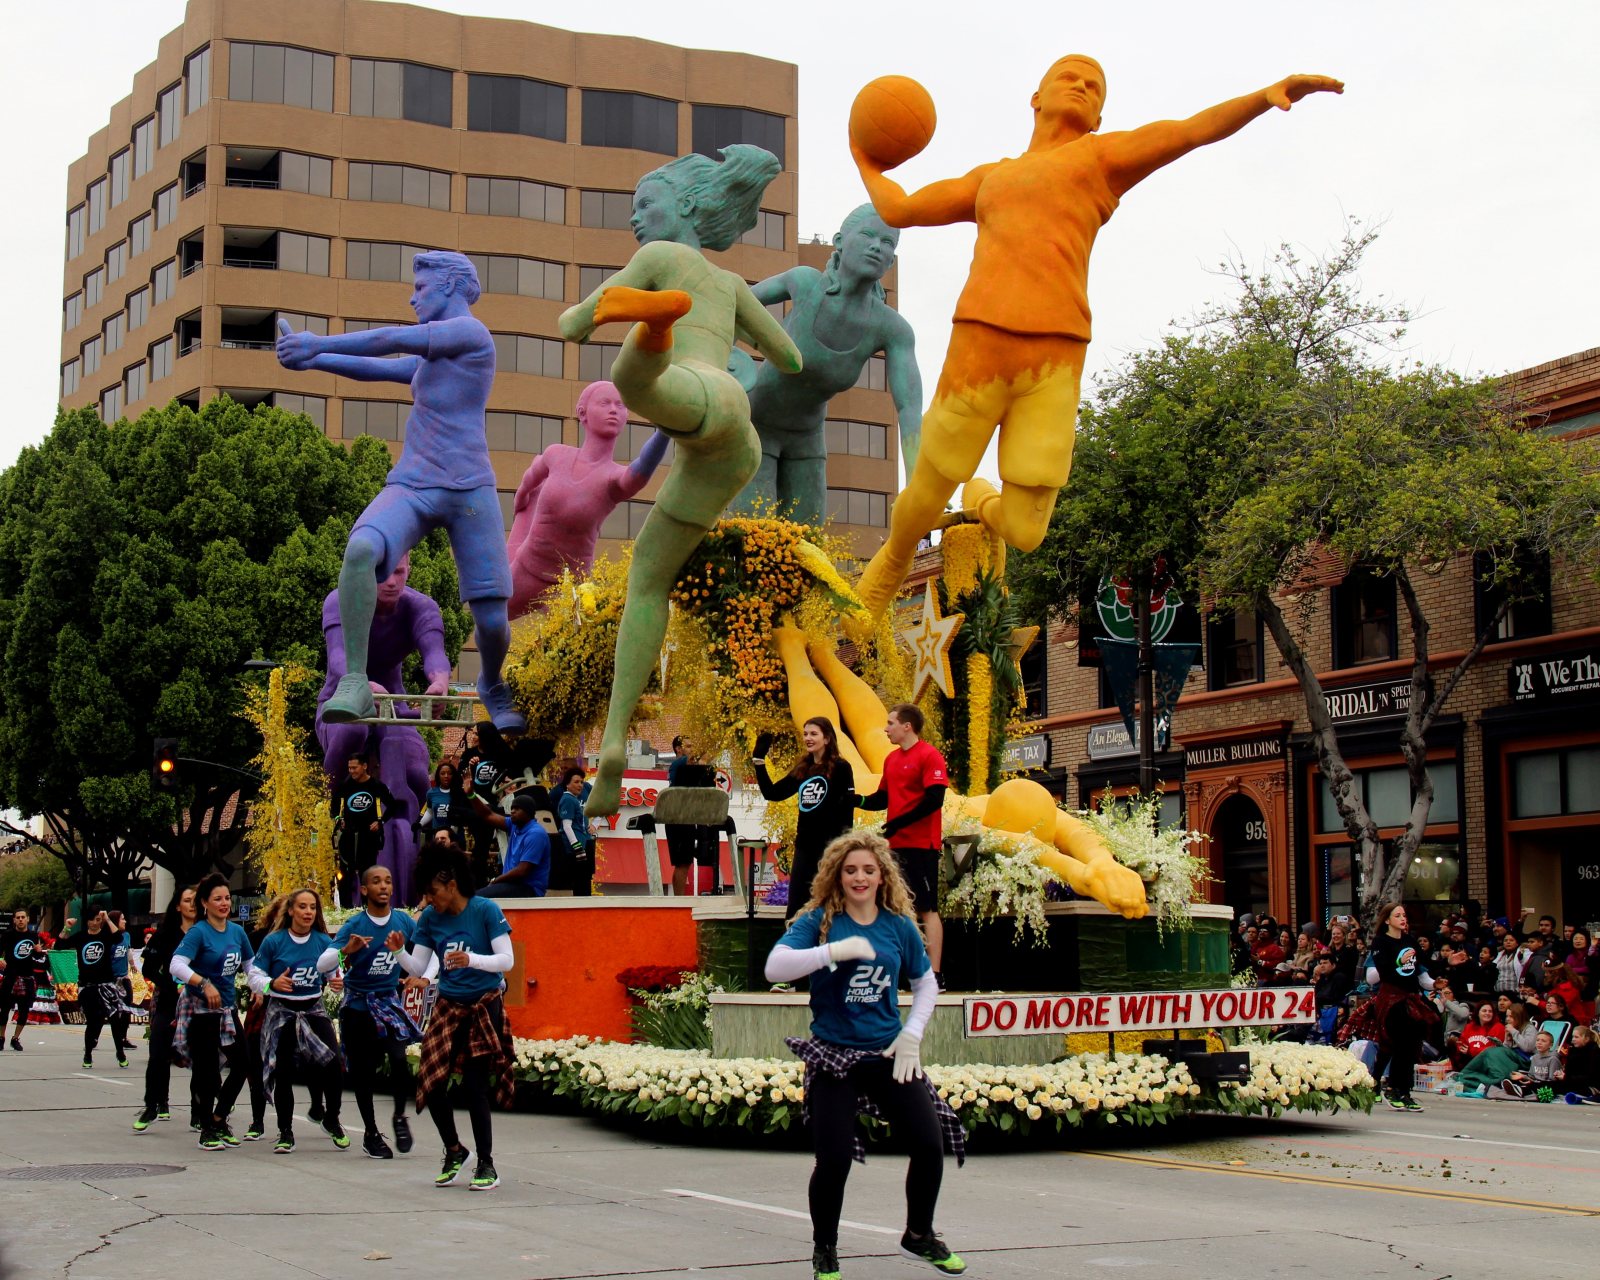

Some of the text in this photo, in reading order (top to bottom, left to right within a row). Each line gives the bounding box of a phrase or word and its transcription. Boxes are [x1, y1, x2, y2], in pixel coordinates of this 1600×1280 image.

[1540, 654, 1600, 687] We Th
[1391, 685, 1411, 698] SPECI
[1551, 685, 1579, 694] DOCUMENT
[1093, 731, 1104, 746] An
[1105, 730, 1130, 747] Elega
[1001, 745, 1039, 764] OME TAX
[1186, 740, 1281, 766] MULLER BUILDING
[480, 766, 497, 777] 24
[619, 787, 658, 807] ESS
[803, 783, 825, 800] 24
[354, 796, 371, 807] 24
[1245, 821, 1268, 840] 959
[1413, 866, 1440, 879] 961
[1578, 865, 1600, 880] 963
[20, 944, 33, 952] 24
[86, 946, 102, 956] 24
[115, 946, 127, 956] 24
[224, 952, 241, 969] 24
[372, 952, 398, 970] 24
[292, 967, 318, 984] 24
[849, 965, 892, 994] 24
[845, 995, 880, 1003] FITNESS
[847, 987, 873, 996] HOUR
[406, 987, 424, 1017] 24
[971, 989, 1316, 1031] DO MORE WITH YOUR 24
